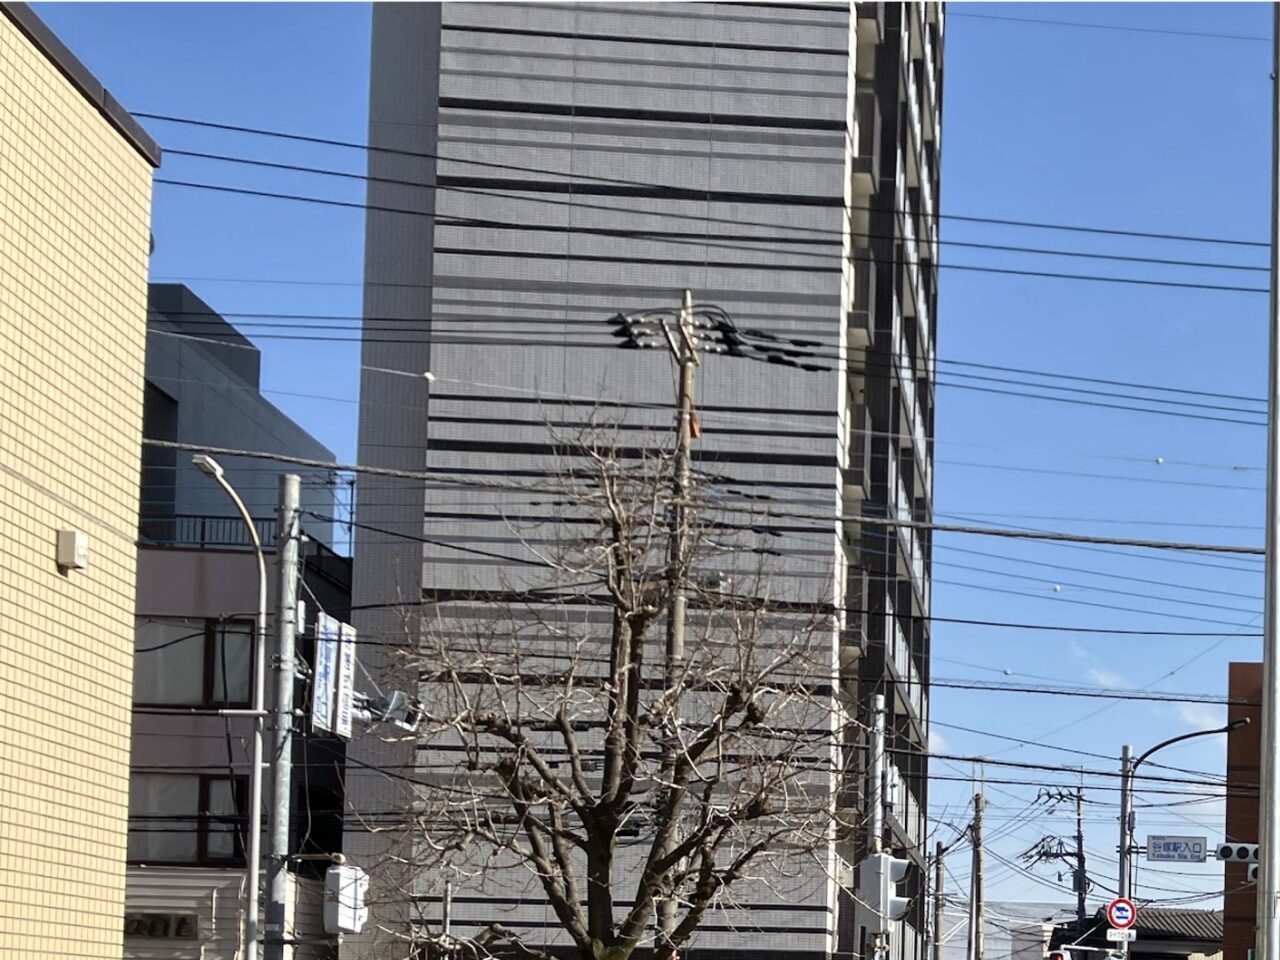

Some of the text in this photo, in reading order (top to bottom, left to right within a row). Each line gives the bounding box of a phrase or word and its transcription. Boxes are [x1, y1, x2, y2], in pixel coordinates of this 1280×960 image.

[1151, 841, 1202, 854] 谷塚駅入口
